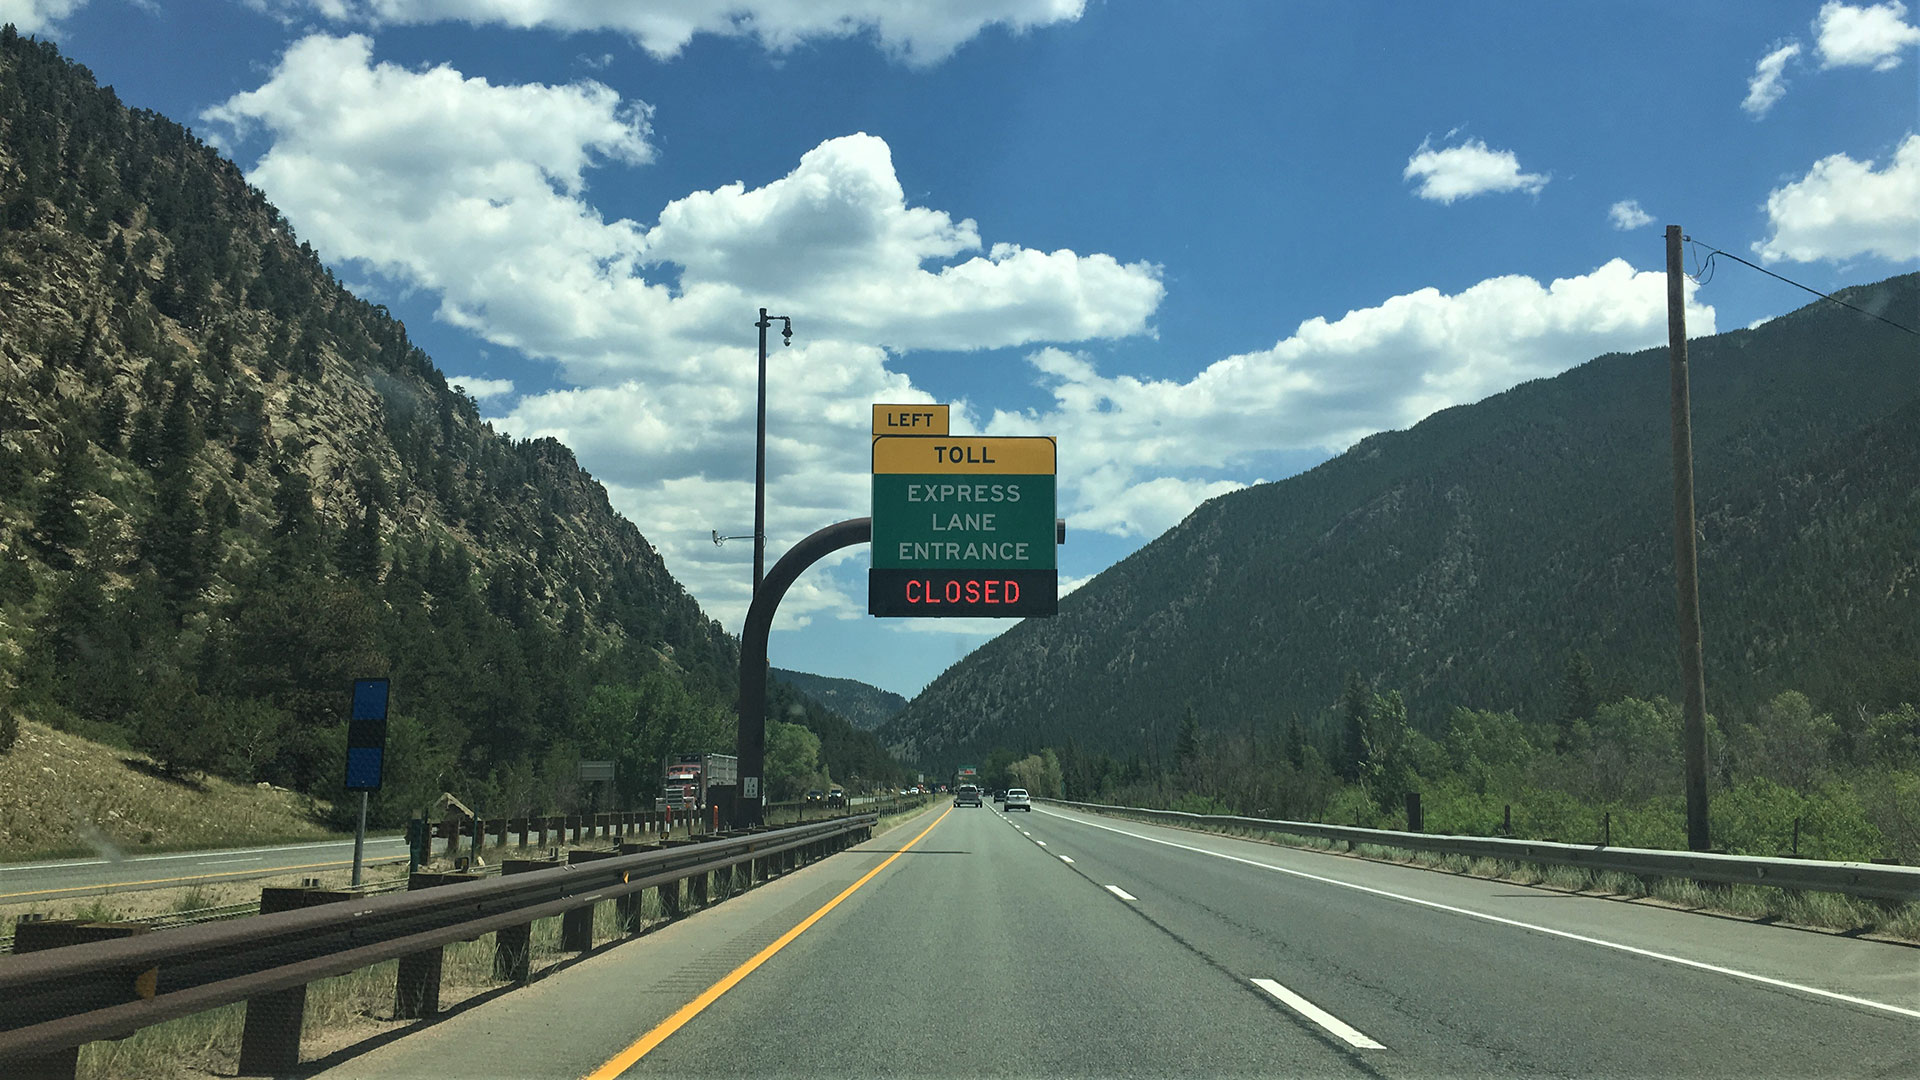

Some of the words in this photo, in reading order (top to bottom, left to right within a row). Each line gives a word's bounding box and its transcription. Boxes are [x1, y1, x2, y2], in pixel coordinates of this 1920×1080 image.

[888, 413, 934, 427] LEFT
[934, 447, 995, 463] TOLL
[908, 485, 1020, 502] EXPRESS
[933, 514, 995, 530] LANE
[900, 543, 1028, 560] ENTRANCE
[907, 580, 1019, 603] CLOSED
